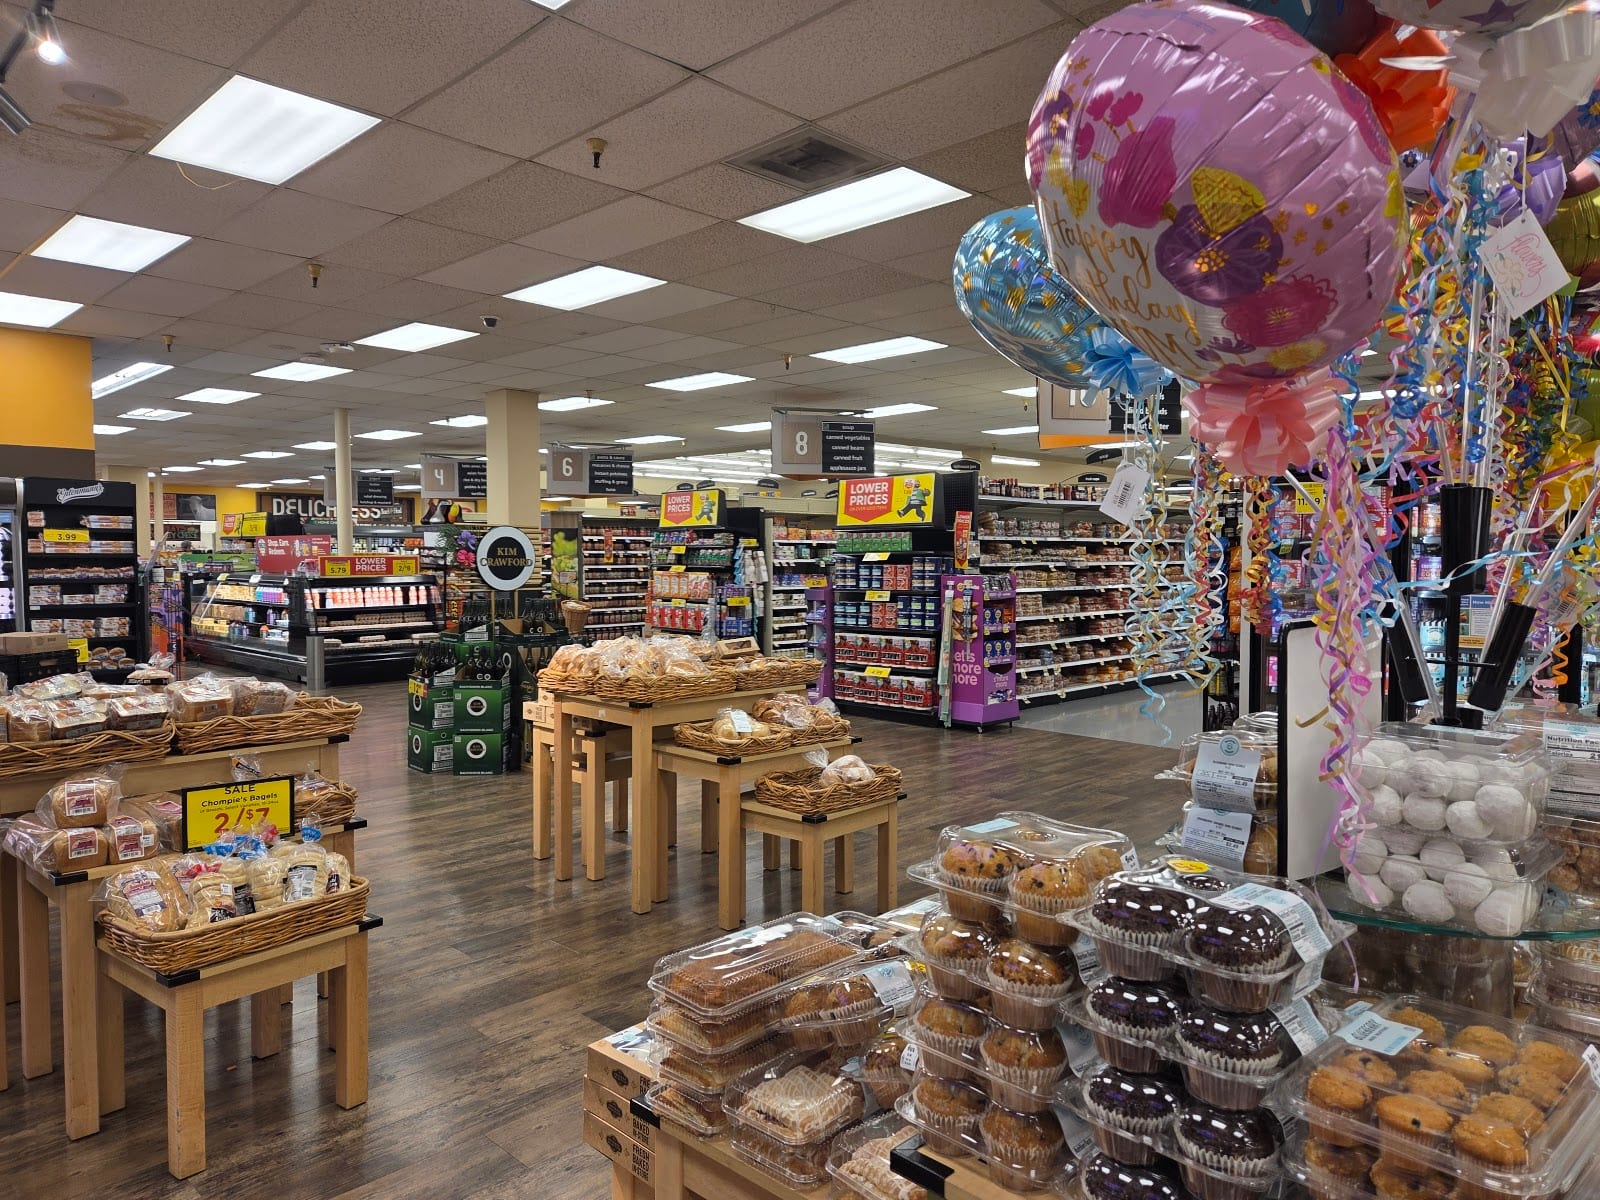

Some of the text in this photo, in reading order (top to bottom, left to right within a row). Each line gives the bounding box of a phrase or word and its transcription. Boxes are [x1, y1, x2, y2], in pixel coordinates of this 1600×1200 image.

[1051, 200, 1151, 289] Happy
[1123, 422, 1170, 431] peaut bter
[795, 431, 808, 456] 8
[844, 434, 871, 442] vegetables
[562, 457, 573, 477] 6
[434, 468, 444, 486] 4
[850, 482, 889, 494] LOWER
[668, 495, 691, 504] LOWER
[849, 494, 889, 507] PRICES
[1297, 497, 1320, 506] 11.9
[667, 504, 691, 513] PRICES
[57, 533, 77, 541] 3.99
[496, 547, 518, 556] KIM
[355, 557, 386, 565] LOWER
[480, 557, 534, 567] CRAWFORD
[355, 564, 387, 572] PRICES
[954, 650, 976, 661] ets
[1547, 735, 1583, 744] Nutrition
[224, 783, 256, 795] SALE
[201, 792, 278, 807] Chompie's Bagels
[214, 807, 270, 834] 2/$7
[632, 1118, 650, 1137] BAKED
[632, 1144, 650, 1161] FRESH
[632, 1153, 650, 1171] BAKED
